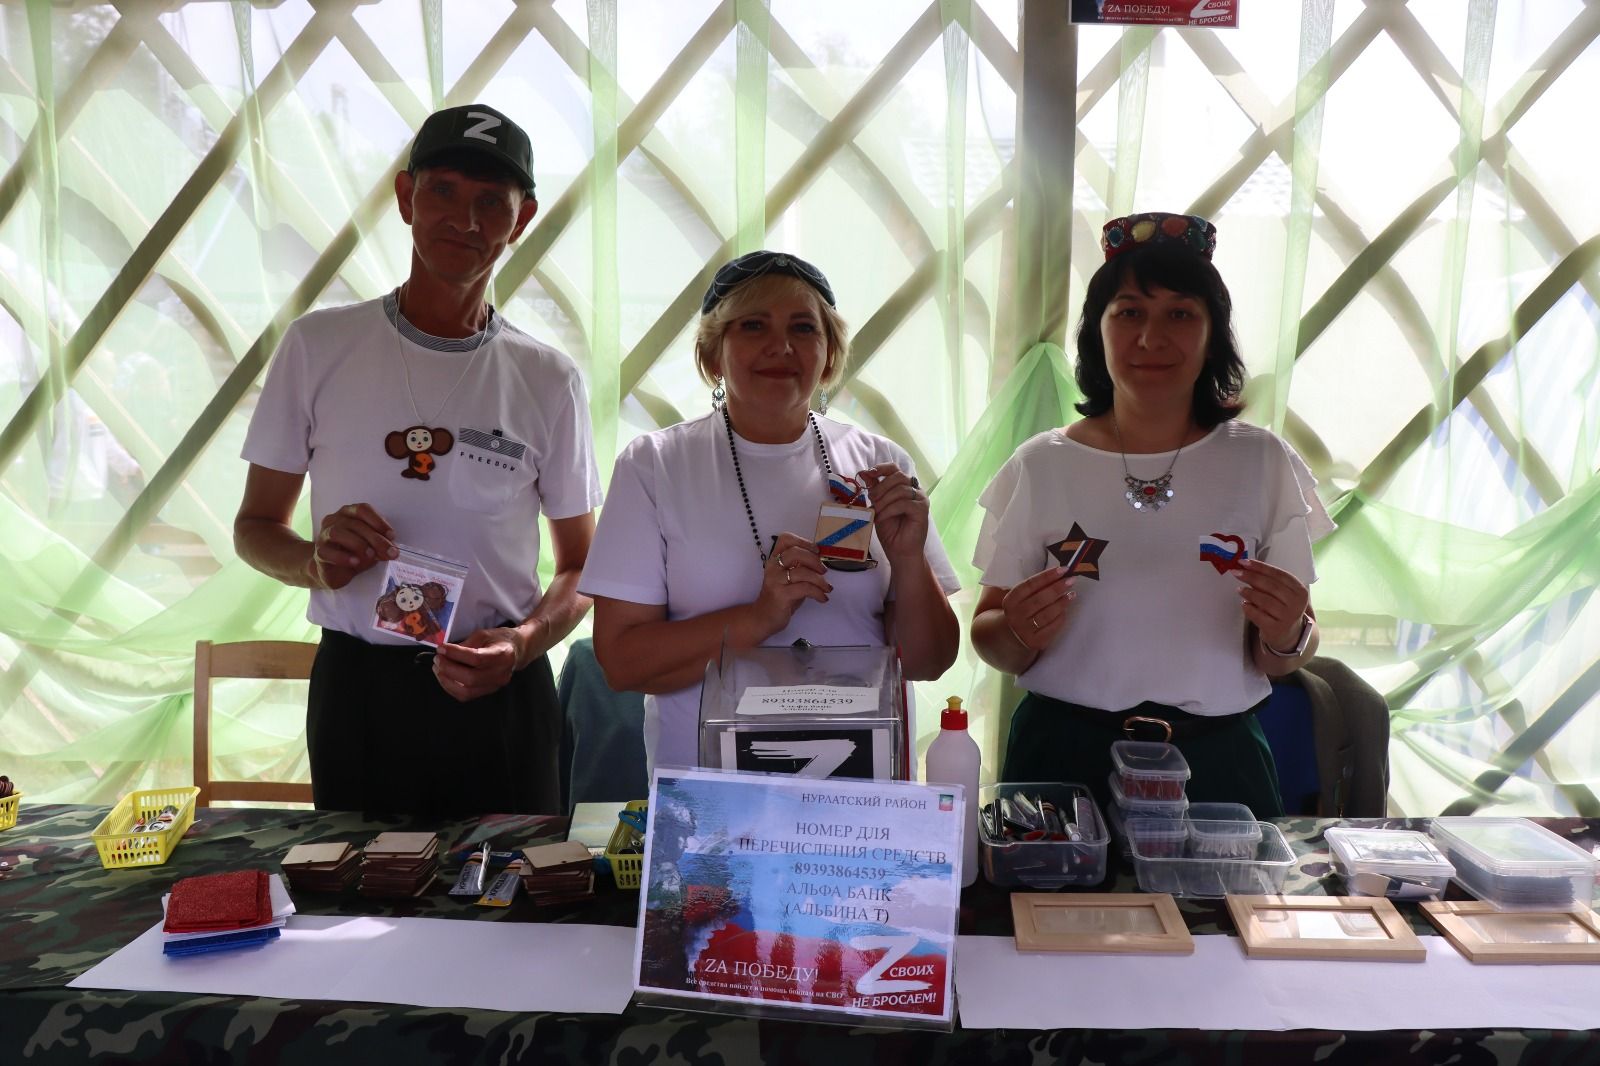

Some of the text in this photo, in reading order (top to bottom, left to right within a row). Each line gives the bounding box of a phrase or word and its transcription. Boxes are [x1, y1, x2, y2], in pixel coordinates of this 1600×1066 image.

[1124, 5, 1170, 14] ПОБЕДУ!
[1207, 0, 1231, 8] СВОИХ
[1199, 15, 1233, 24] БРОСАЕМ!
[463, 111, 502, 145] Z
[801, 793, 927, 810] НУРЛАТСКИЙ РАЙОН
[795, 822, 890, 841] НОМЕР ДЛЯ
[739, 838, 946, 864] ПЕРЕЧИСЛЕНИЯ СРЕДСТВ
[794, 862, 886, 880] 89393864539
[786, 881, 892, 902] АЛЬФА БАНК
[785, 903, 868, 921] (АЛЬБИНА
[734, 961, 819, 982] ПОБЕДУ!
[849, 934, 934, 995] Z
[889, 965, 935, 978] СВОИХ
[825, 991, 844, 999] СВО
[852, 993, 937, 1008] НЕ БРОСАЕМ!
